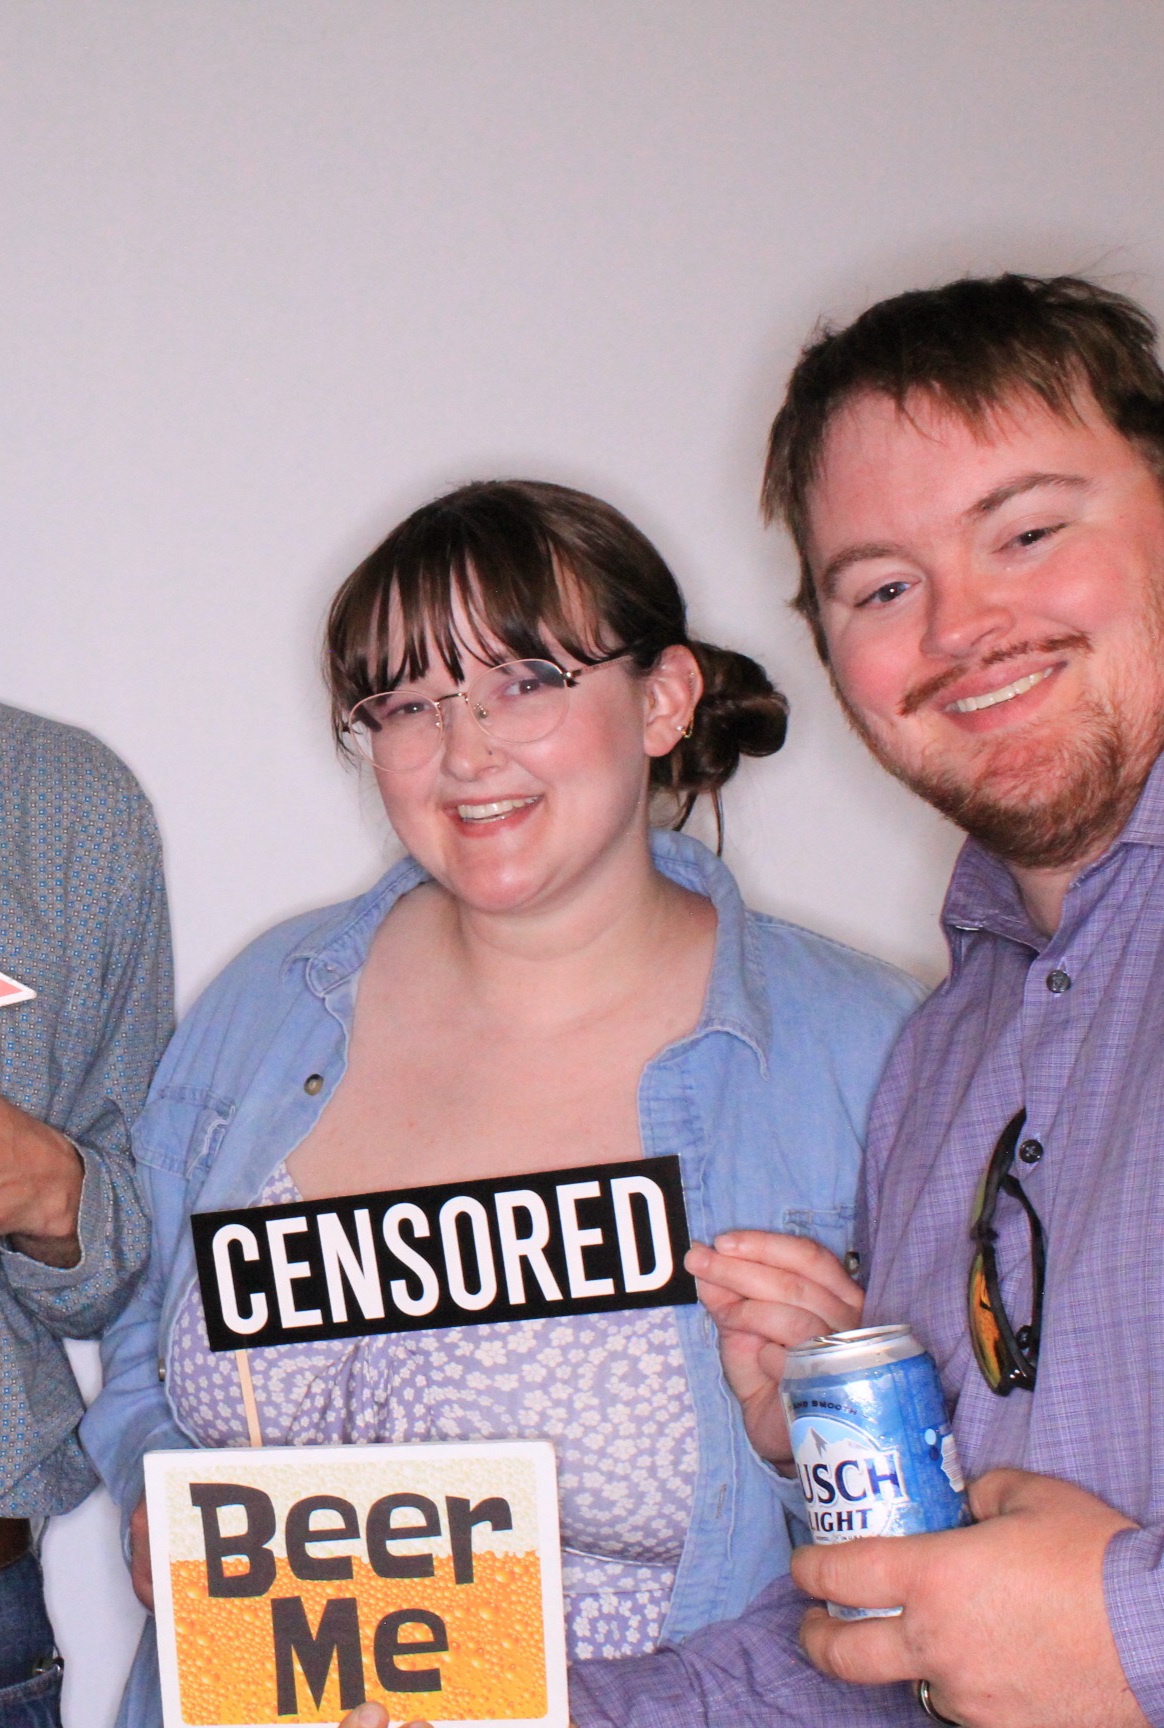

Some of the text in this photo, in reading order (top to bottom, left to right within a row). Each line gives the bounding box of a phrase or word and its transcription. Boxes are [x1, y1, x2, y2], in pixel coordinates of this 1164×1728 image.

[211, 1174, 674, 1335] CENSORED
[811, 1400, 858, 1416] SMOOTH
[797, 1453, 905, 1504] USCH
[808, 1507, 873, 1532] LIGHT
[188, 1482, 513, 1599] Beer
[270, 1594, 450, 1718] Me
